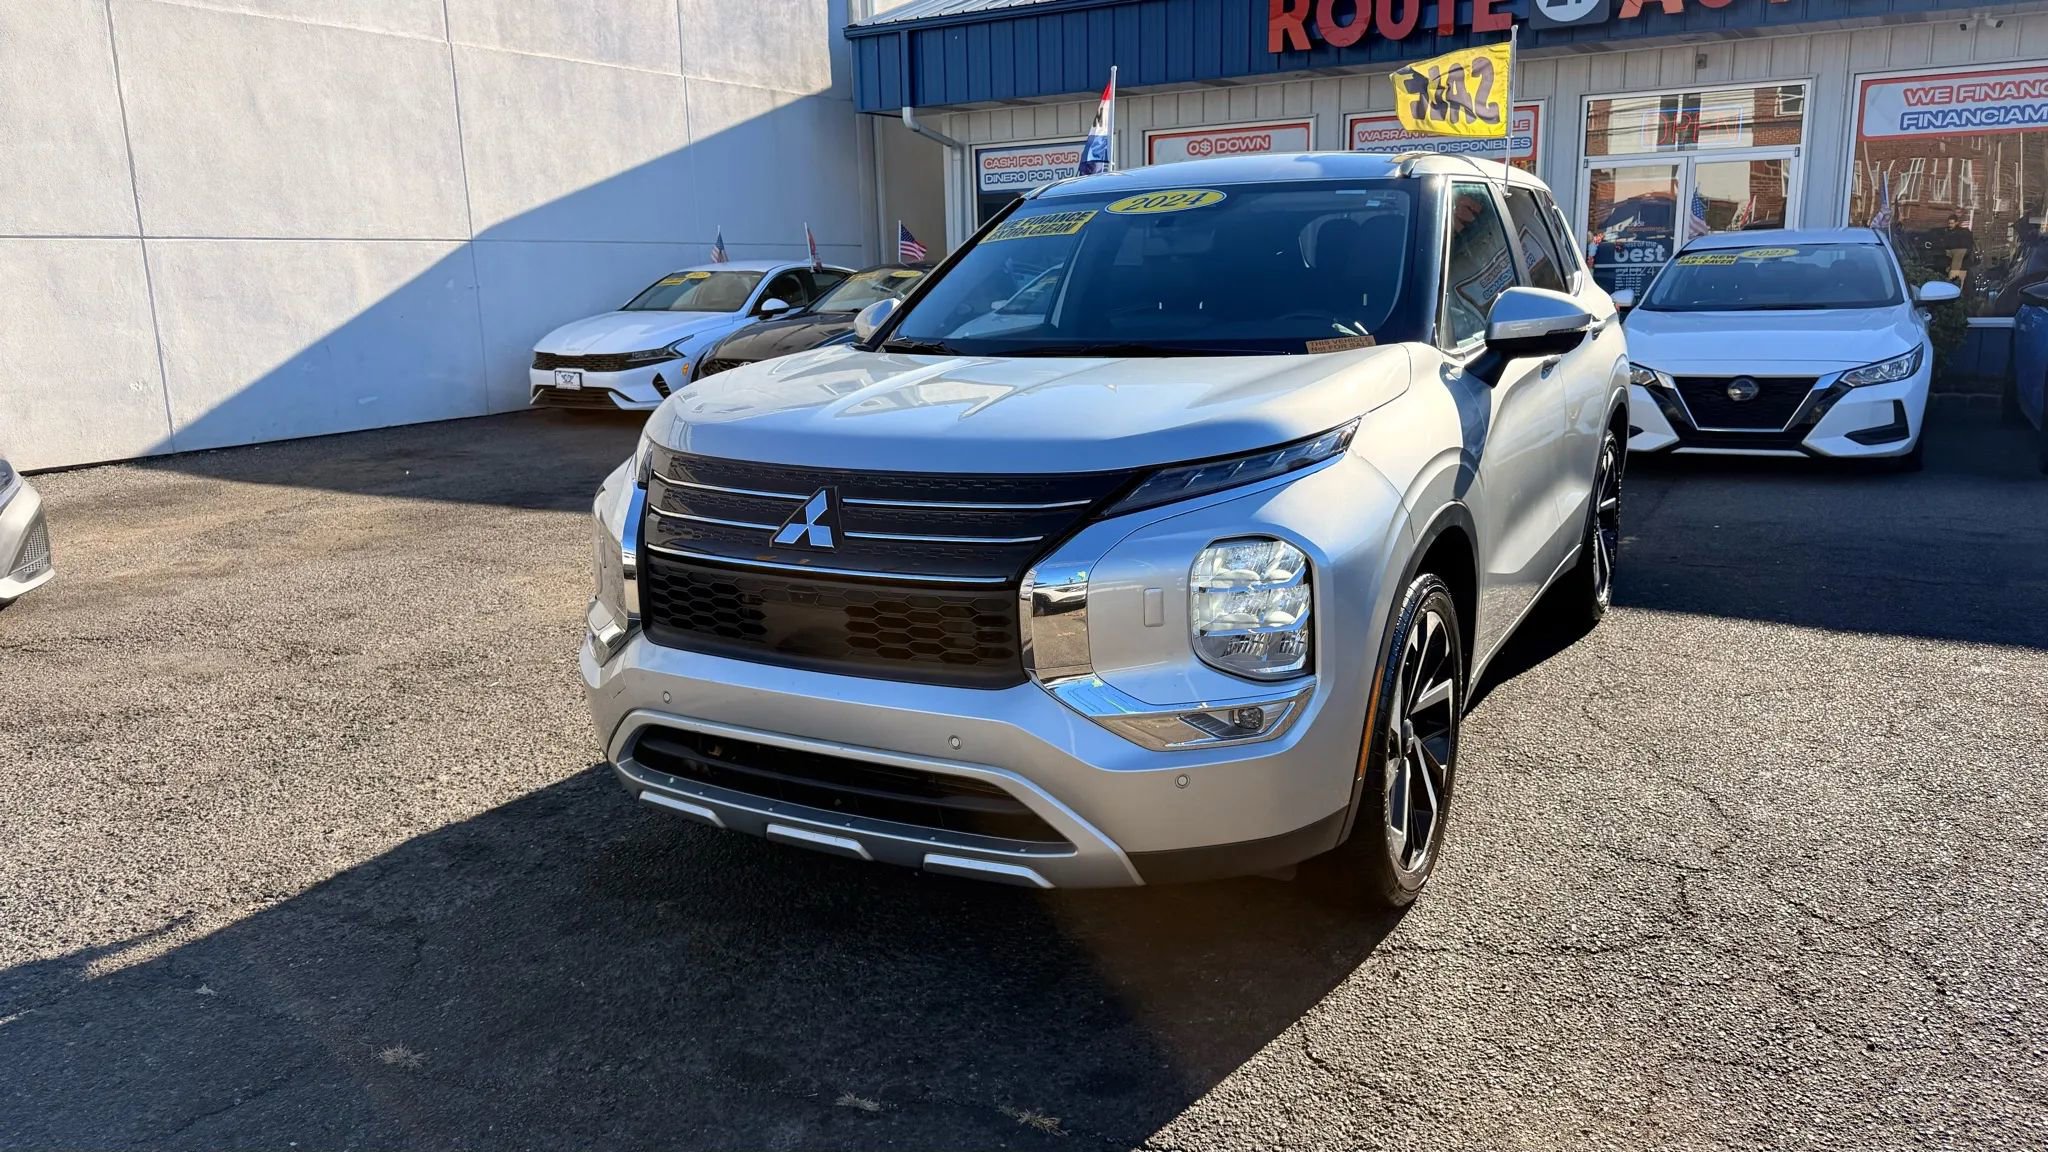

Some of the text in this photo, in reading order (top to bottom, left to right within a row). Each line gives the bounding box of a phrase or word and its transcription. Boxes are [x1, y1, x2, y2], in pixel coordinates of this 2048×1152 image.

[1903, 85, 1953, 107] WE
[1900, 102, 2048, 130] FINANCIAM
[1645, 111, 1739, 145] OPEN
[1214, 135, 1271, 153] DOWN
[984, 152, 1079, 169] CASH FOR YOUR
[984, 167, 1074, 184] DINERO POR TU
[1123, 192, 1209, 211] 2024
[1021, 211, 1094, 226] FINANCE
[987, 222, 1077, 241] EXTRA CLEAN
[1614, 244, 1665, 263] best
[1332, 336, 1371, 345] VEHICLE
